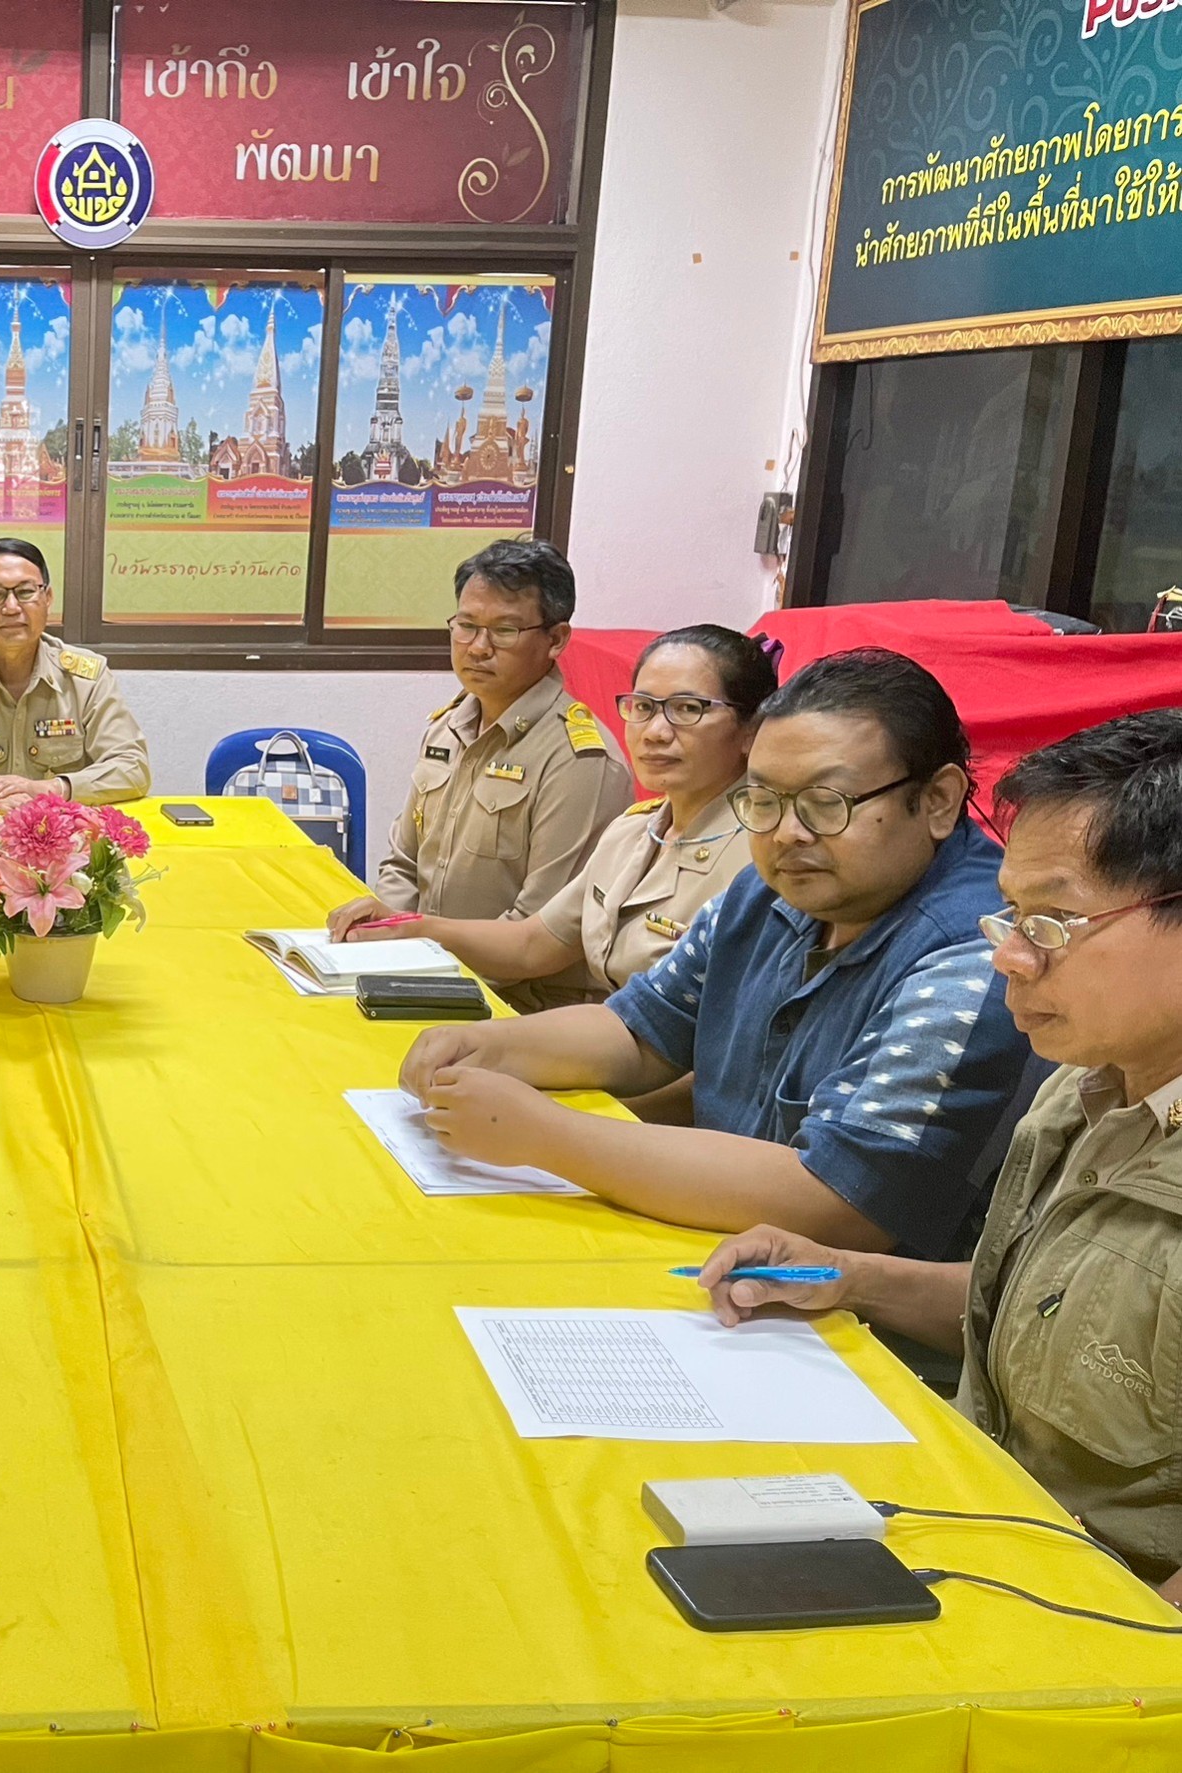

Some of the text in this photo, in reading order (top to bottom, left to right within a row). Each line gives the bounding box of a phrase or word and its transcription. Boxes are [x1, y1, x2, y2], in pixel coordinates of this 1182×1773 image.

[144, 38, 466, 102] เข้าถึง เข้าใจ
[234, 129, 380, 183] พัฒนา
[881, 102, 1182, 205] การพัฒนาศักยภาพโดยการ
[1081, 1353, 1153, 1398] OUTDOORS
